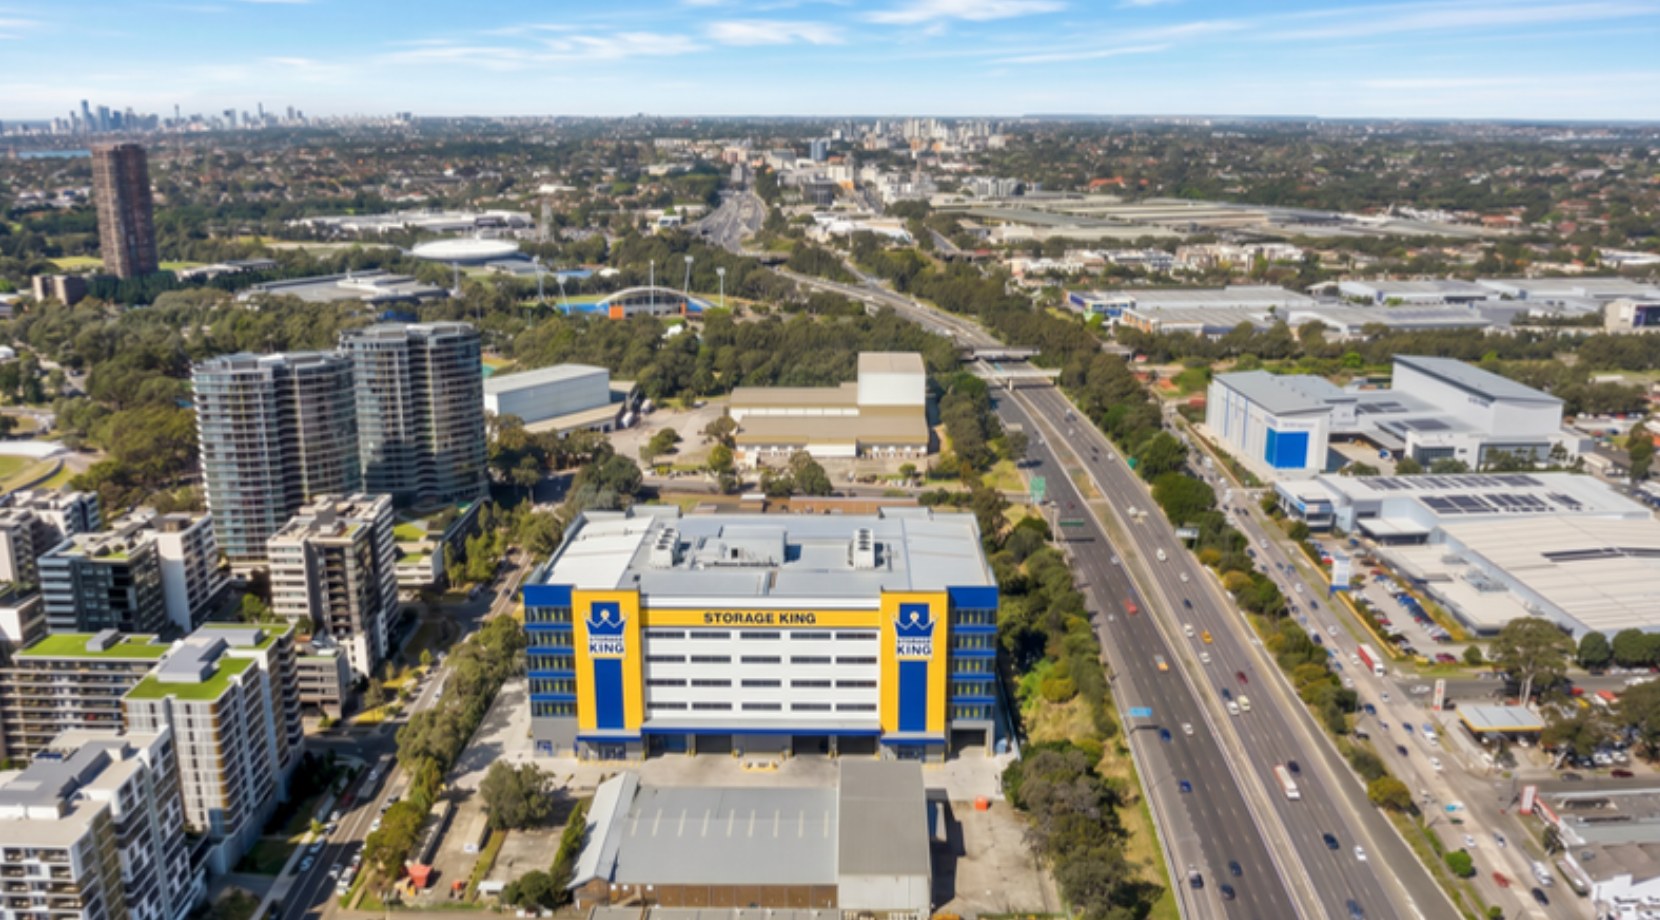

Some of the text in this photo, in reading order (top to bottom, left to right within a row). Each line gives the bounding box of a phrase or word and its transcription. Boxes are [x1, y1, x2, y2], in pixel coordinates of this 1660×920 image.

[704, 612, 816, 624] STORAGE KING
[589, 642, 624, 653] KING
[897, 645, 931, 655] KING
